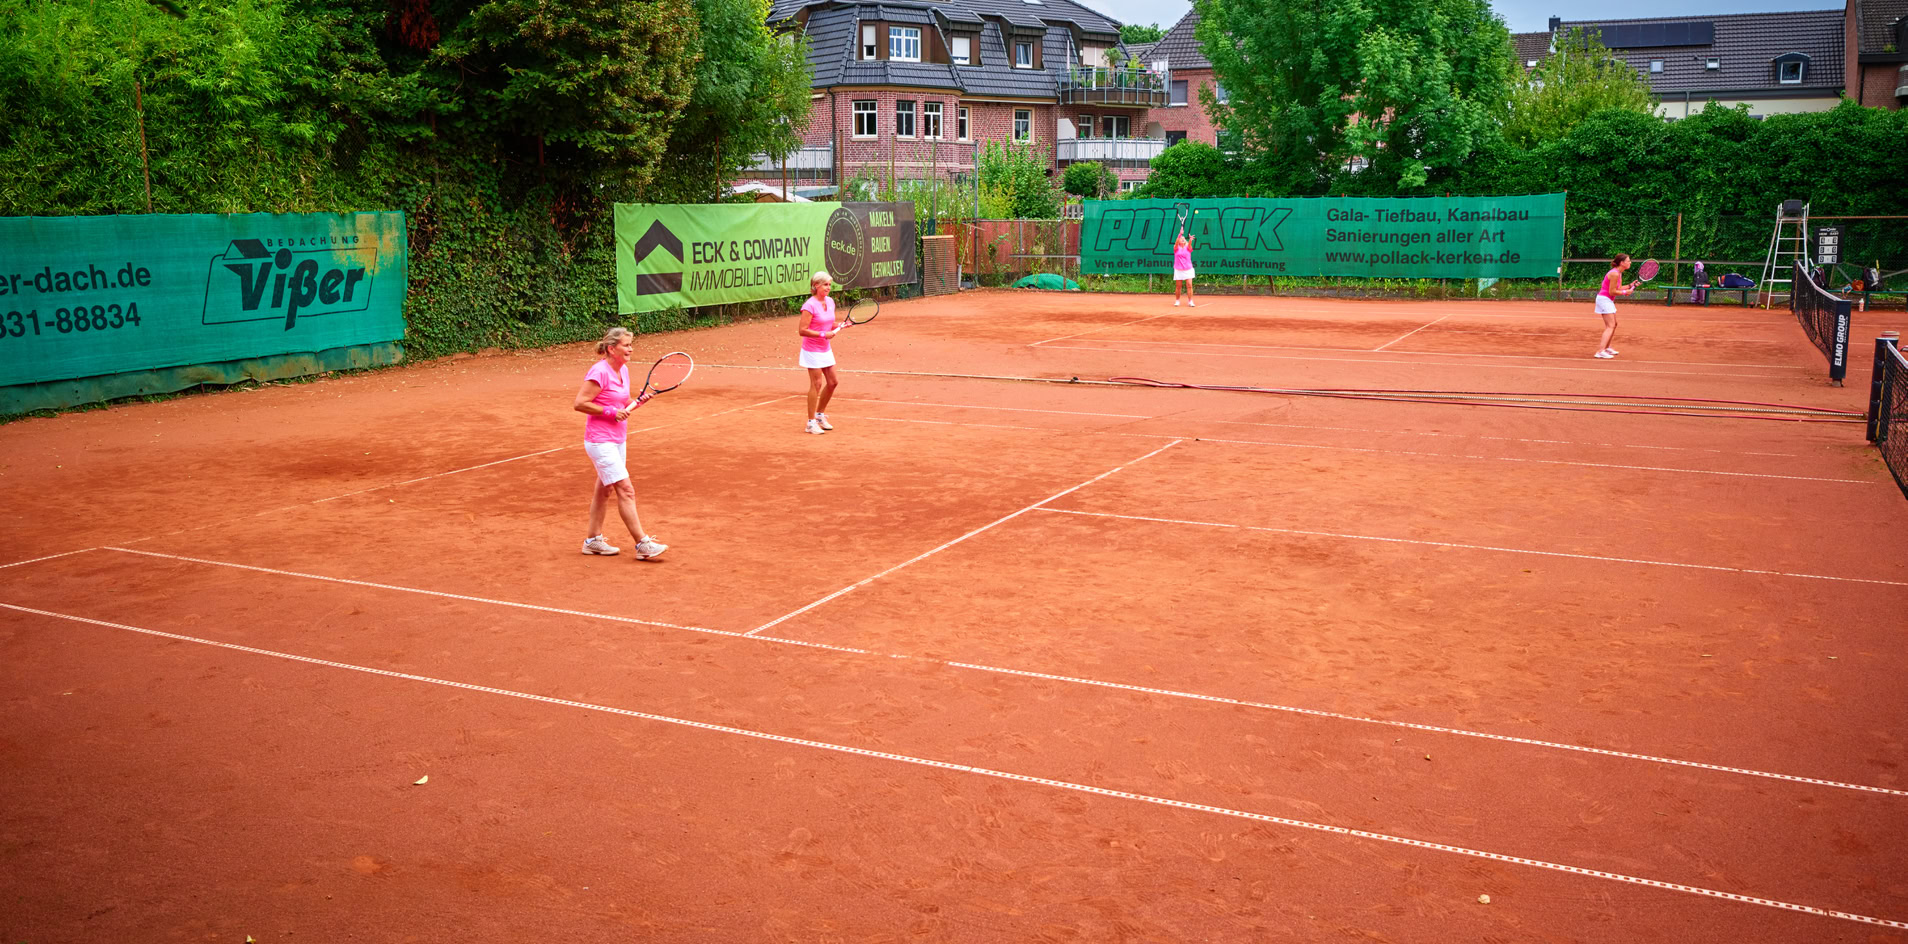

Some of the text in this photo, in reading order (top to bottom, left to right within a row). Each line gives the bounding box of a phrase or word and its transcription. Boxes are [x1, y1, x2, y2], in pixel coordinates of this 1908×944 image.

[869, 211, 896, 227] MAKELN.
[1327, 208, 1529, 224] Gala- Tiefbau, Kanalbau
[1326, 228, 1505, 247] Sanierungen aller Art
[692, 236, 811, 264] ECK & COMPANY
[831, 240, 856, 256] eck.de
[1094, 258, 1114, 269] Von
[1117, 258, 1134, 268] der
[1137, 258, 1172, 268] Planun
[1200, 260, 1217, 268] zur
[1220, 258, 1286, 272] Ausführung
[1326, 250, 1521, 267] www.pollack-kerken.de
[690, 262, 810, 291] IMMOBILIEN GMBH
[224, 248, 366, 332] Vißer
[1836, 314, 1846, 343] GROUP
[1834, 343, 1844, 366] ELMO
